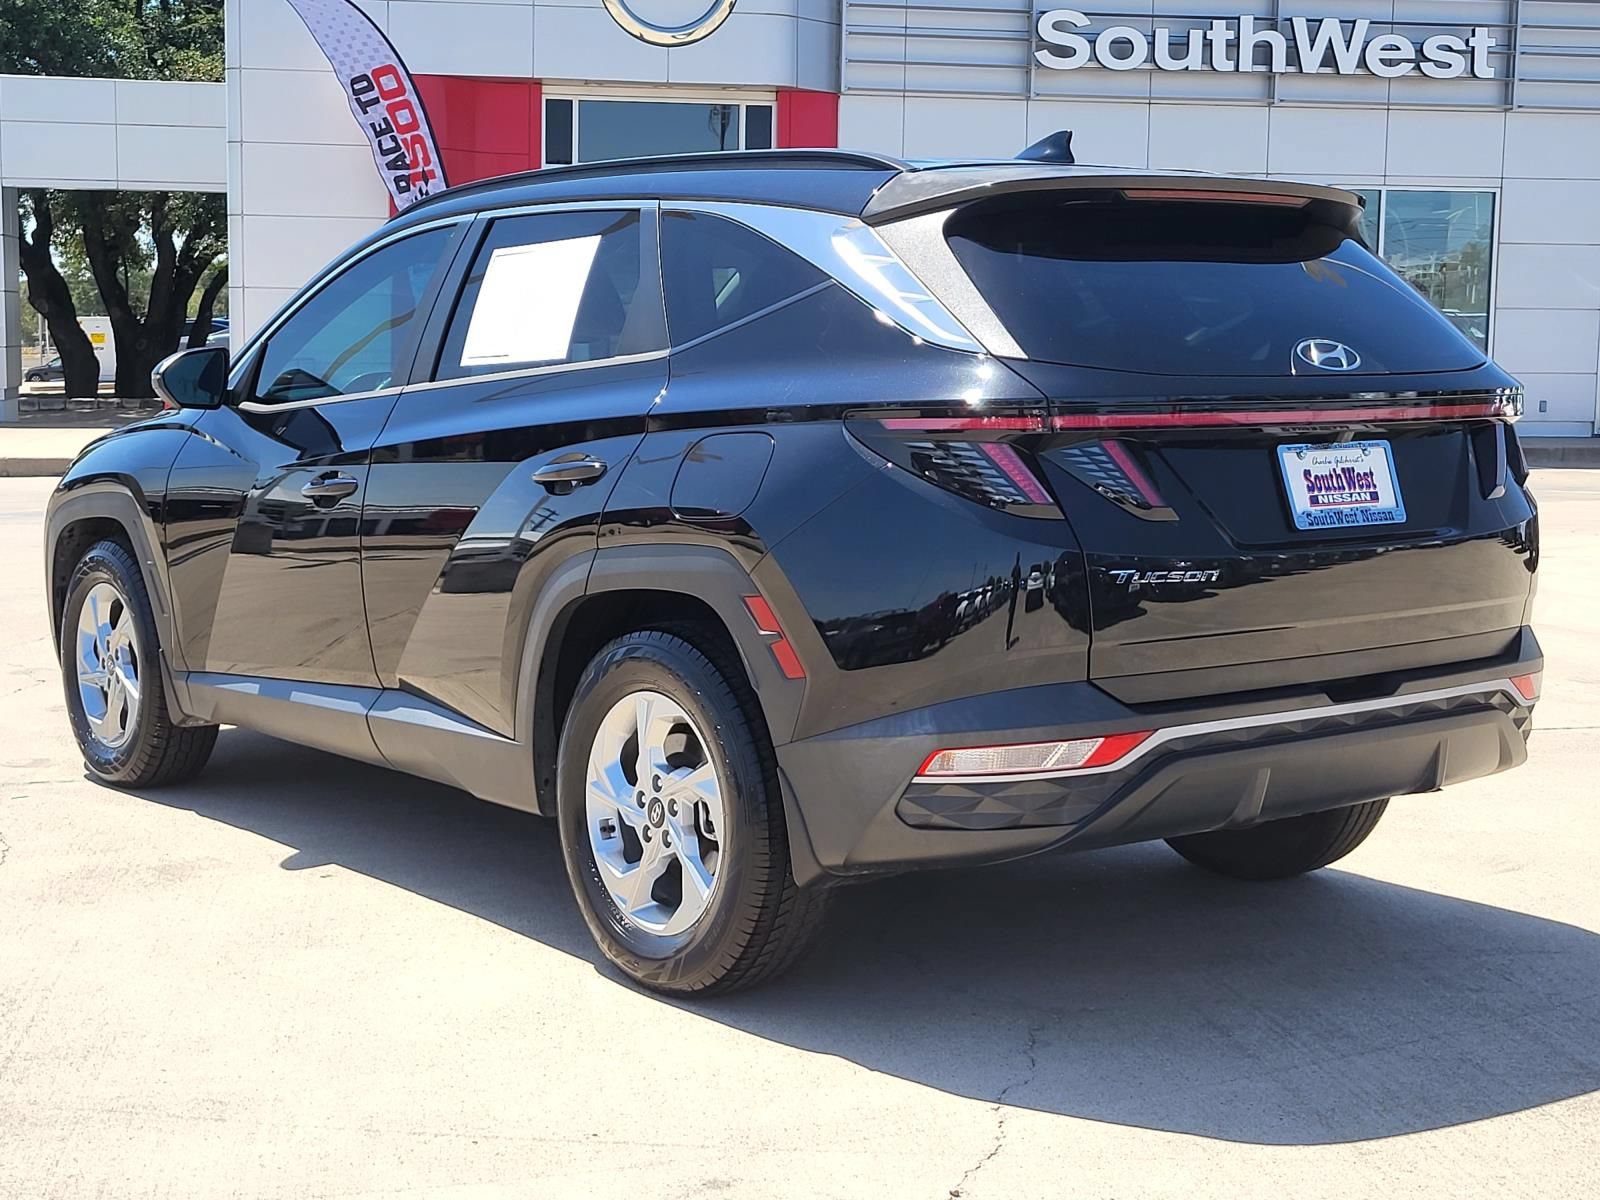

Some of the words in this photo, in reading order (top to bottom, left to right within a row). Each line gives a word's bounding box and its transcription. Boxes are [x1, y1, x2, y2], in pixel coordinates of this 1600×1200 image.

[1034, 9, 1497, 79] SouthWest
[350, 73, 381, 115] TO
[371, 64, 437, 188] 1500
[369, 116, 412, 194] RACE
[1303, 466, 1377, 494] SouthWest
[1317, 492, 1371, 504] NISSAN
[1306, 509, 1359, 526] SouthWest
[1361, 509, 1395, 523] Nissan
